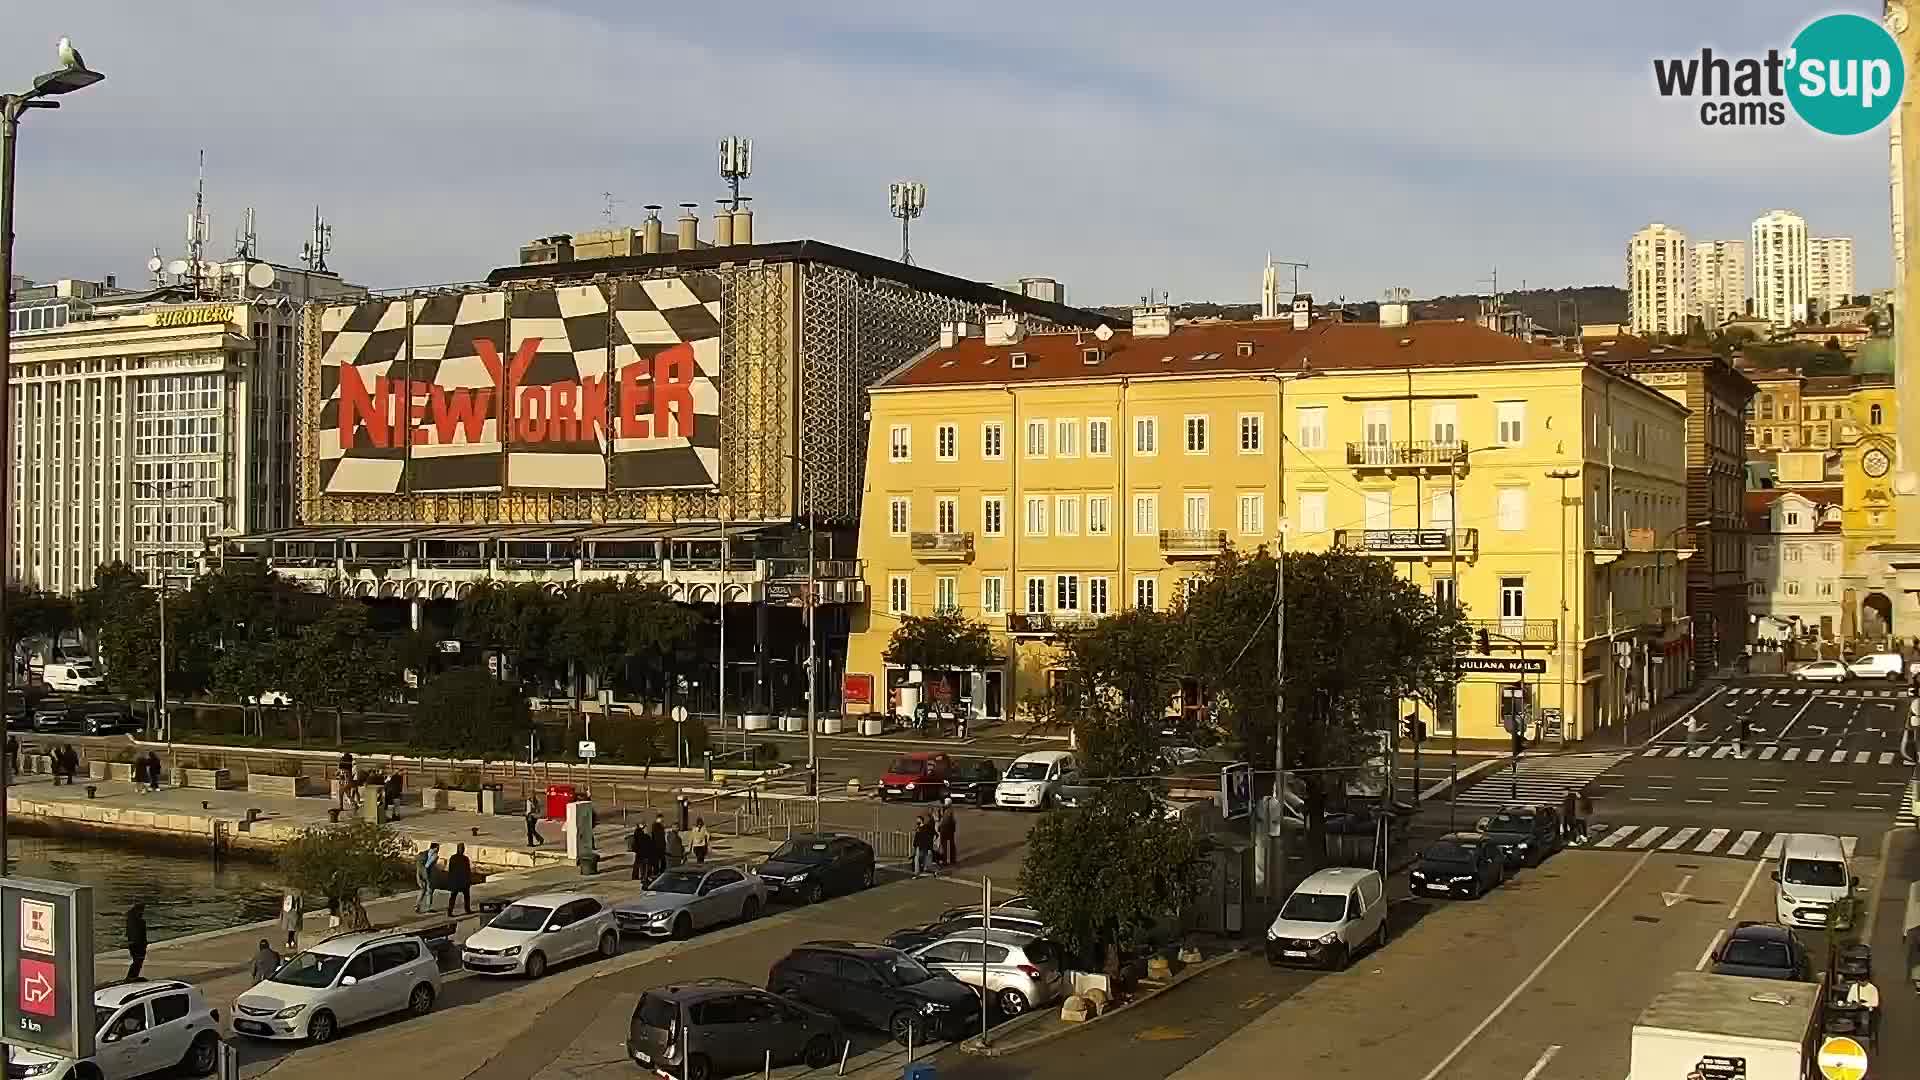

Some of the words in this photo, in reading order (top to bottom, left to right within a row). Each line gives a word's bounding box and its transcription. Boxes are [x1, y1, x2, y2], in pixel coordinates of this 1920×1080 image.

[1459, 661, 1506, 670] JULIANA
[20, 1018, 27, 1030] 5
[28, 1019, 42, 1033] km
